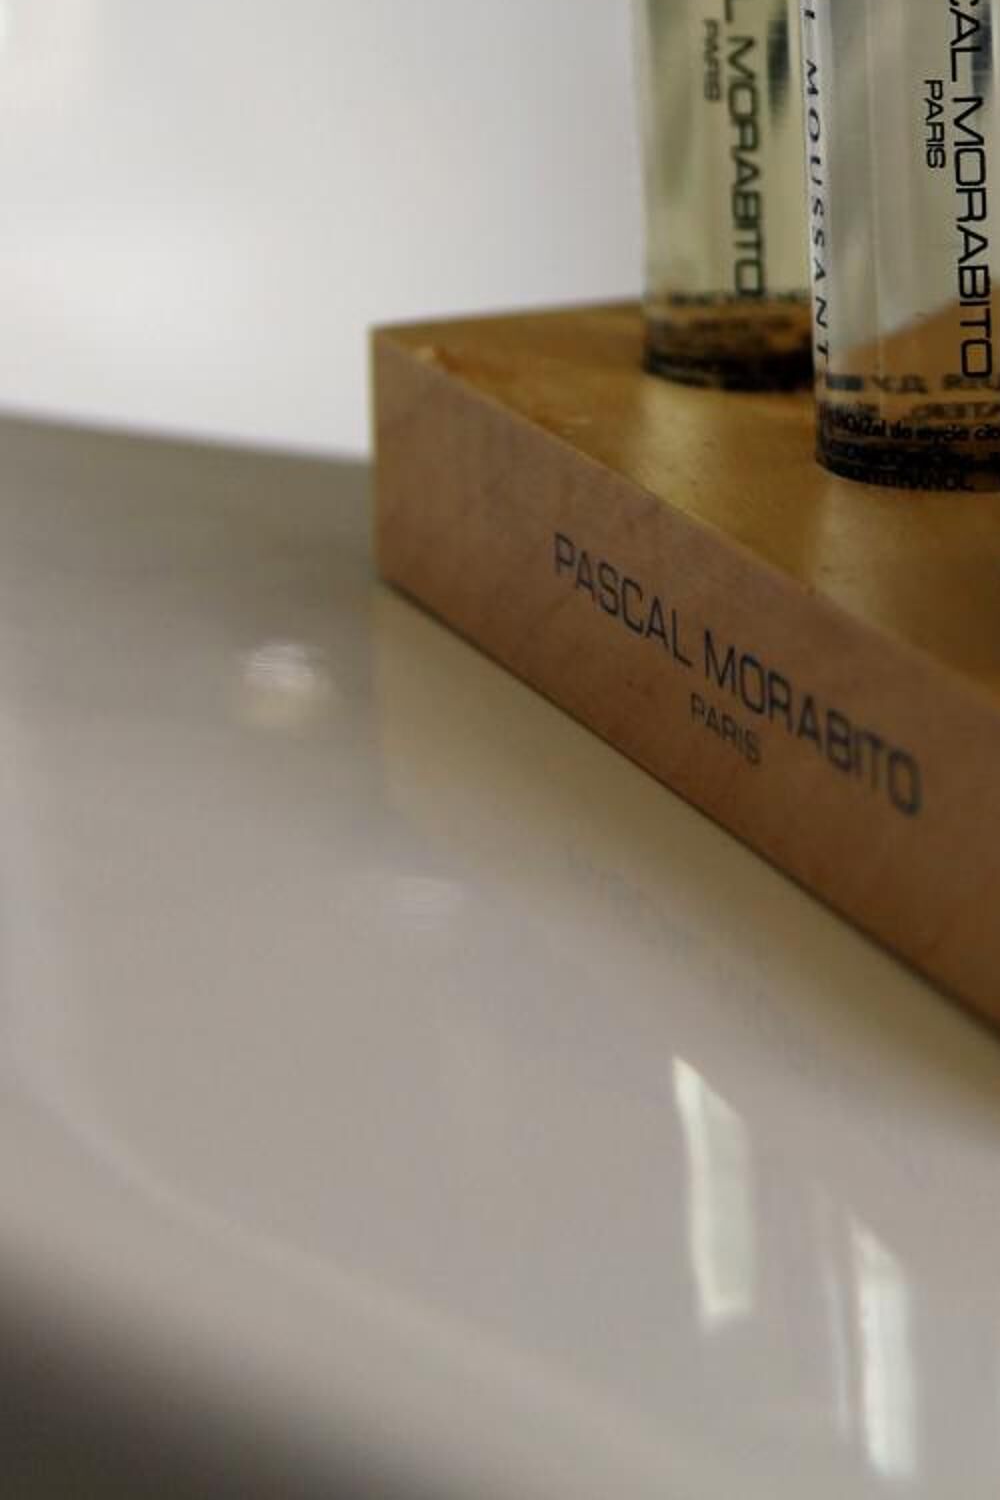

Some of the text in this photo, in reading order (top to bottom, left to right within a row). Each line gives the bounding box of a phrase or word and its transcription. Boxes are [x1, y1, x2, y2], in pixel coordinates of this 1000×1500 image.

[704, 19, 721, 101] PARIS
[725, 35, 768, 295] MORABITO
[924, 79, 945, 169] PARIS
[804, 58, 830, 360] MOUSSANT
[950, 95, 993, 379] MORABITO
[554, 531, 922, 816] PASCAL MORABITO
[690, 693, 762, 766] PARIS
